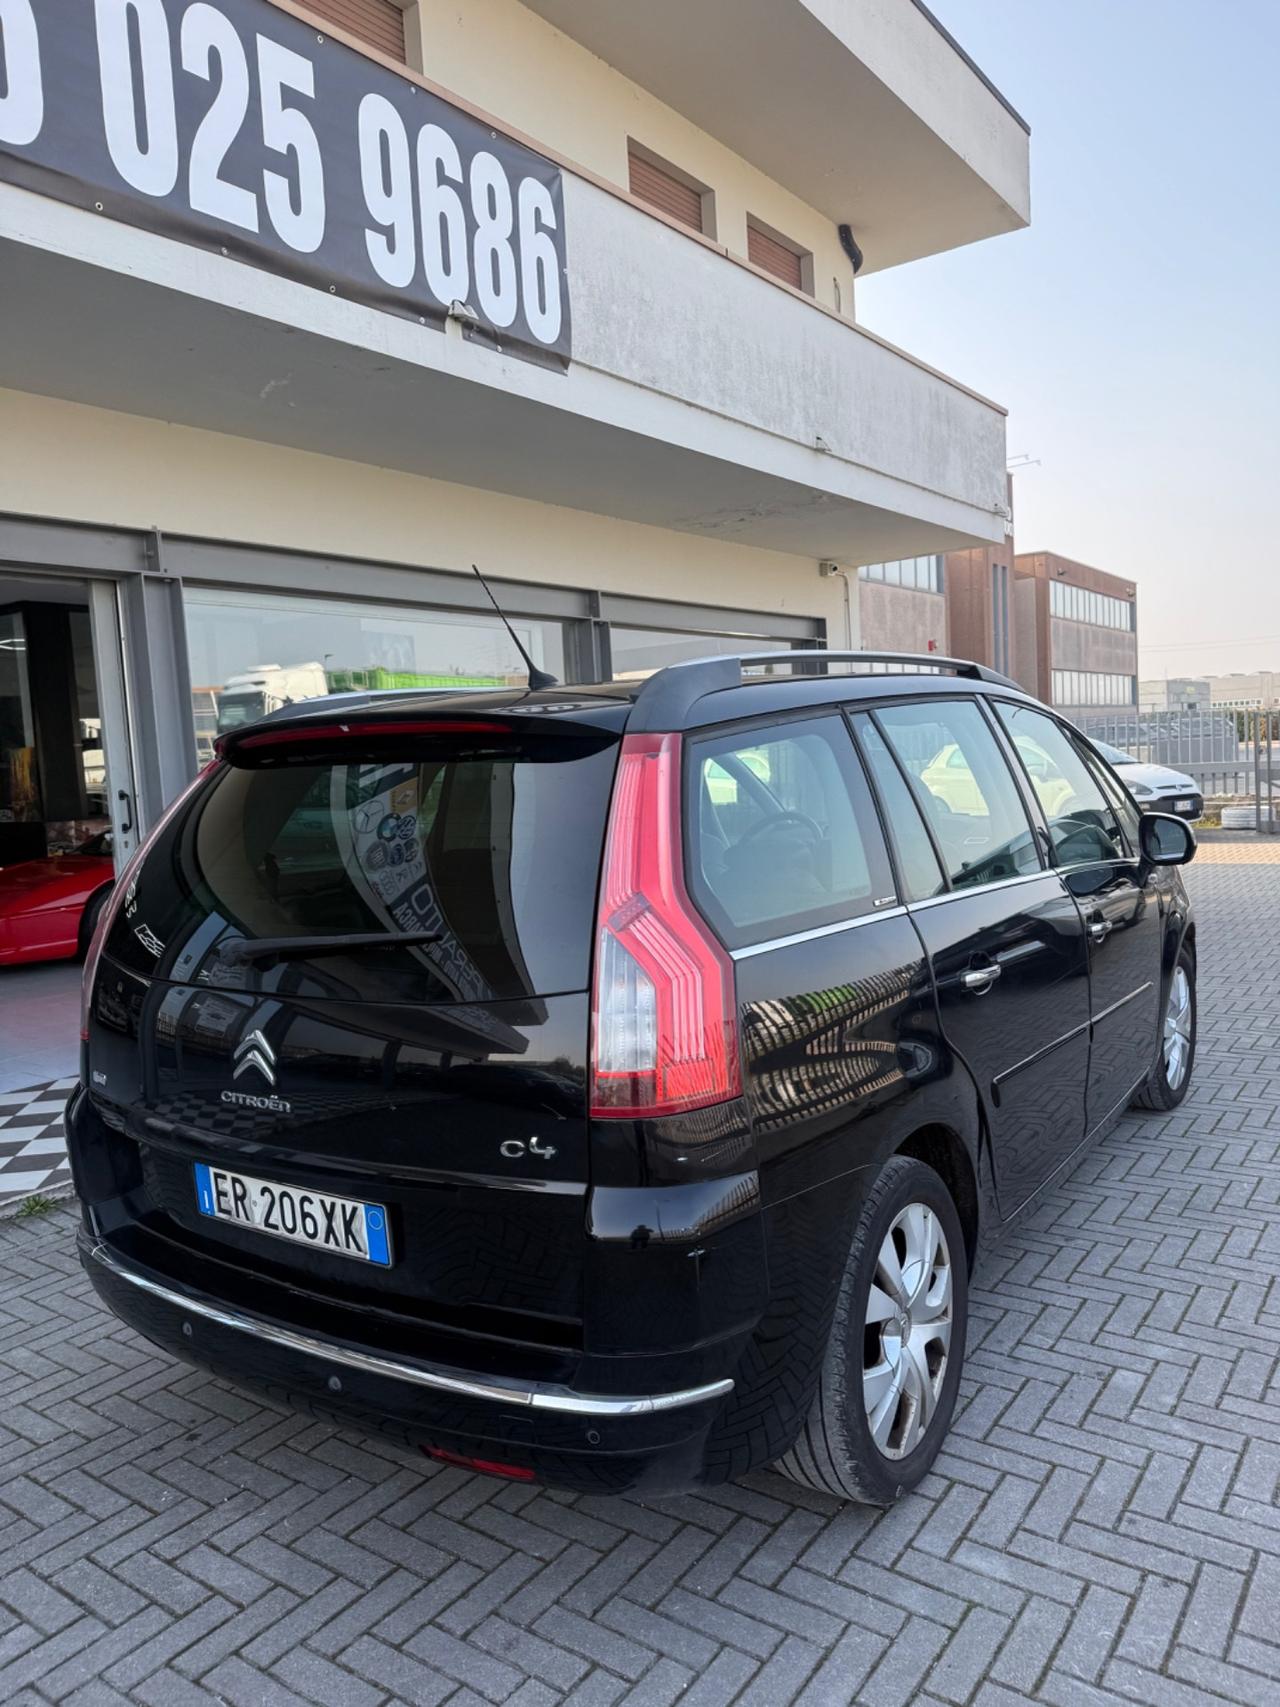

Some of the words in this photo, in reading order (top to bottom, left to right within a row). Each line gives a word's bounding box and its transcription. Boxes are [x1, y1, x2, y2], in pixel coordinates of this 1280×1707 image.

[95, 0, 326, 253] 025
[358, 92, 562, 345] 9686
[220, 1090, 291, 1113] CITROËN
[500, 1136, 556, 1159] C4
[213, 1171, 251, 1222] ER
